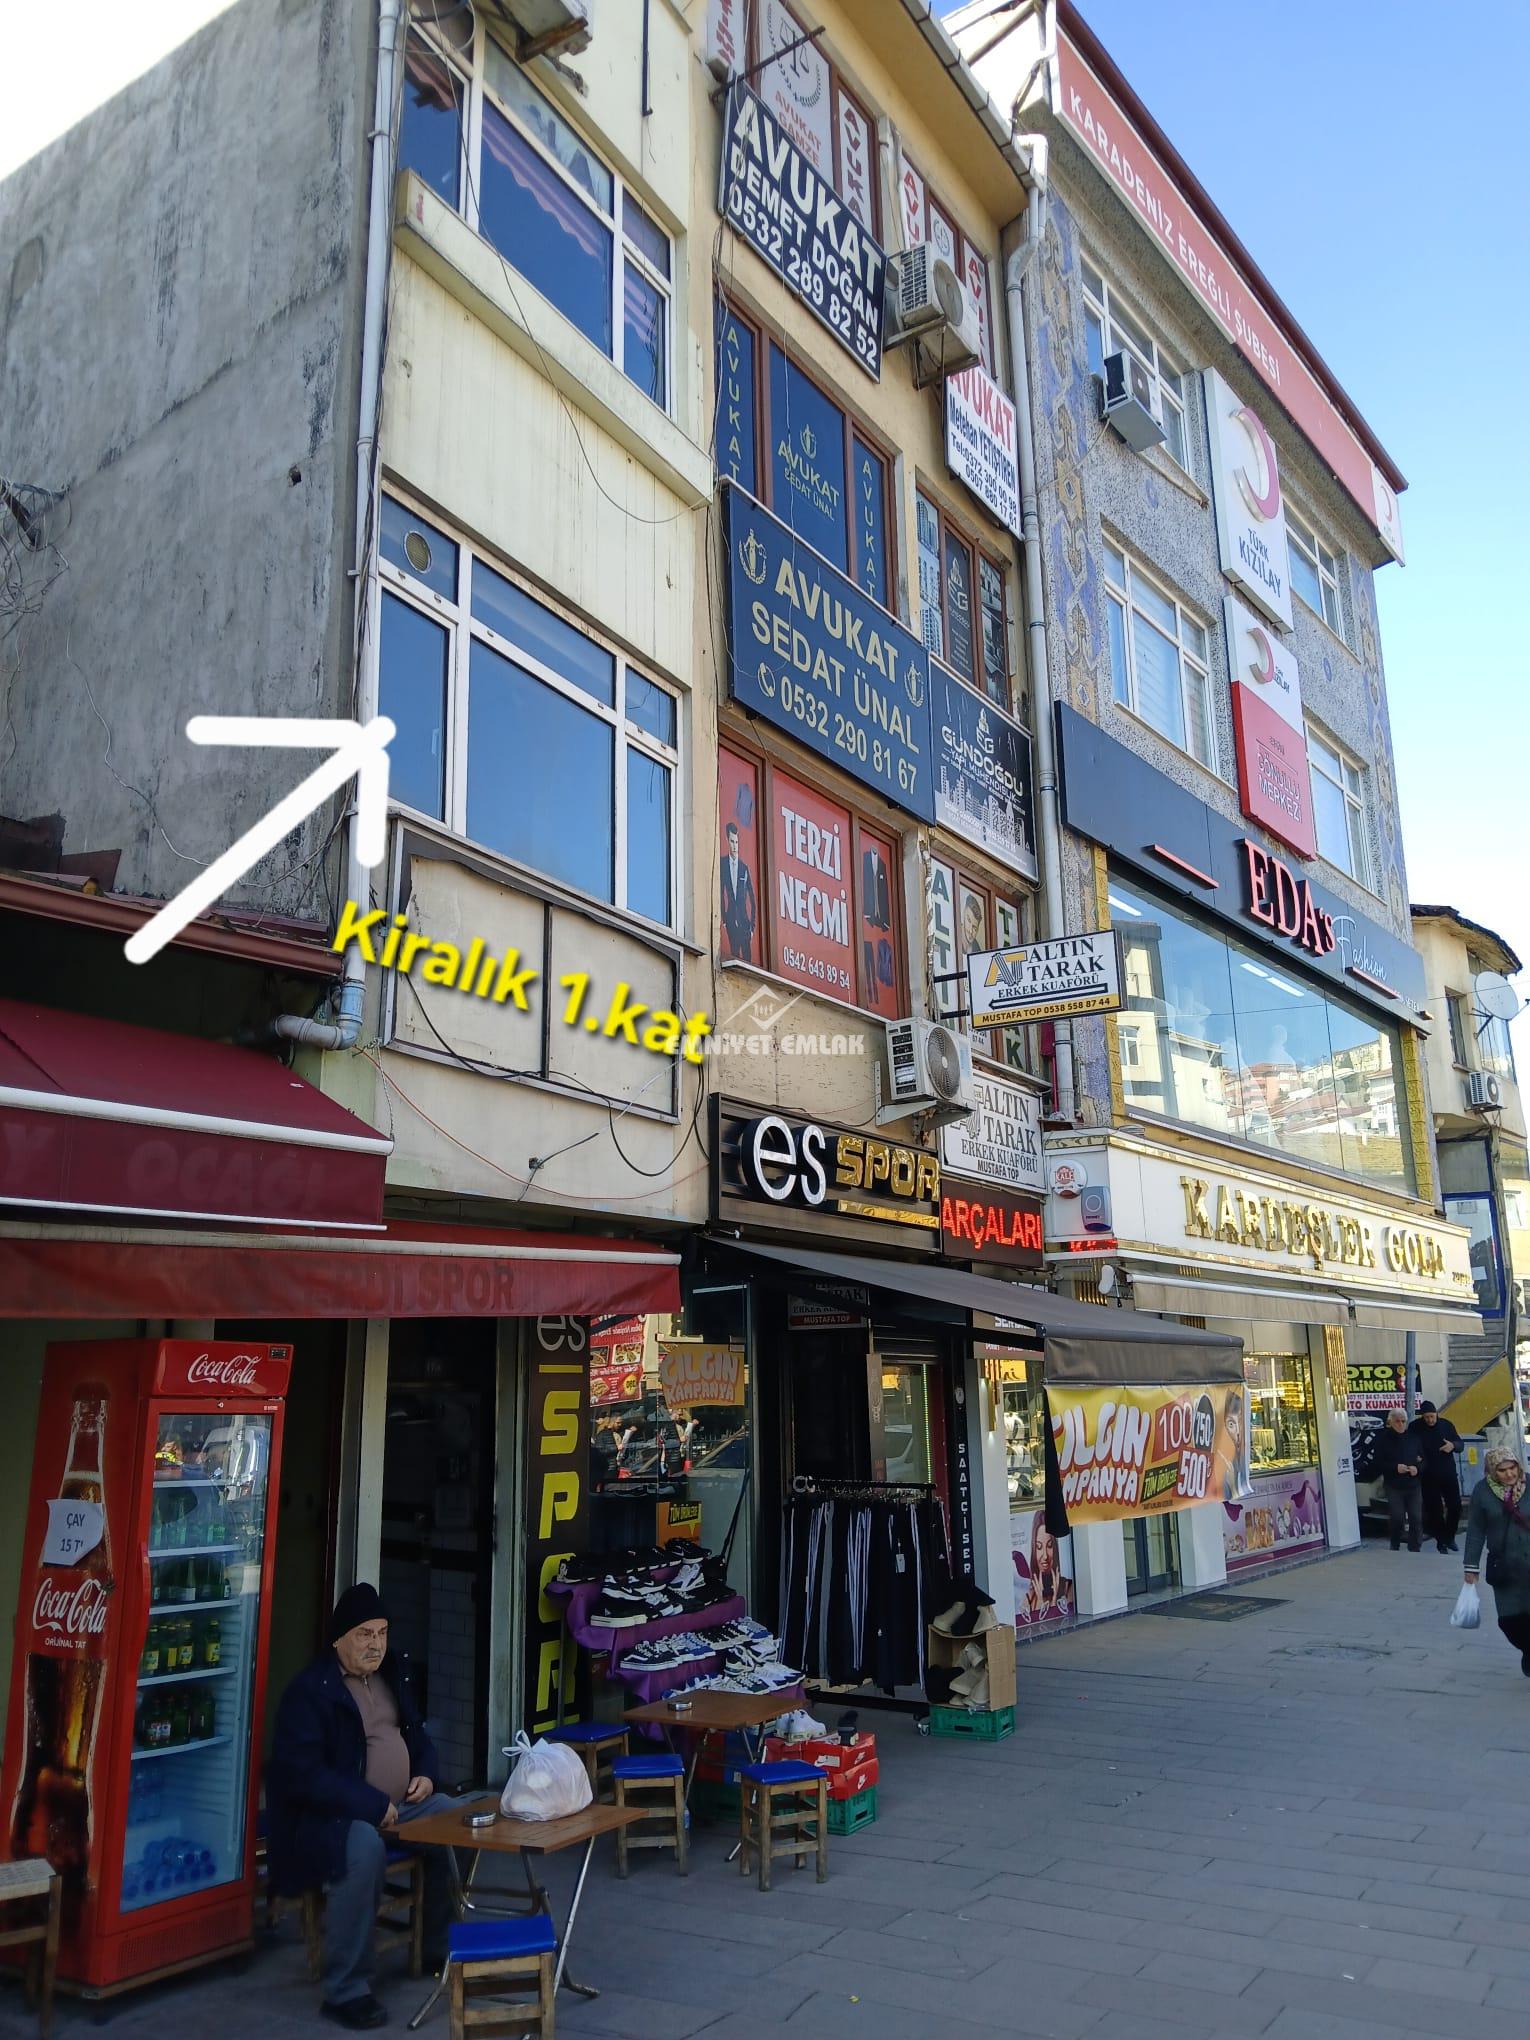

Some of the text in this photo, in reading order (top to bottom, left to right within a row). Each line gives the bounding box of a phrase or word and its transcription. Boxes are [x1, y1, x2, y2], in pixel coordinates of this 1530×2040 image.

[775, 90, 822, 151] AVUKAT
[843, 107, 865, 226] AVUKA
[734, 98, 882, 293] AVUKAT
[903, 170, 920, 249] AVU
[730, 142, 879, 335] DEMET DOĞAN
[1069, 85, 1282, 387] KARADENİZ EREĞLİ ŞUBESİ
[729, 183, 878, 368] 0532 289 82 52
[726, 326, 742, 482] AVUKAT
[949, 369, 1013, 452] AVUKAT
[949, 393, 978, 449] Metehan
[777, 439, 840, 507] AVUKAT
[784, 468, 812, 501] SEDAT
[862, 459, 876, 598] AVUKAT
[1247, 528, 1270, 562] TÜRK
[1239, 535, 1282, 599] KIZILAY
[774, 557, 899, 683] AVUKAT
[751, 601, 846, 698] SEDAT
[853, 667, 920, 755] ÜNAL
[780, 675, 829, 738] 0532
[834, 713, 867, 762] 290
[872, 740, 892, 779] 81
[897, 756, 918, 795] 67
[1257, 752, 1301, 800] GÖNÜLLÜ
[781, 806, 842, 881] TERZİ
[778, 869, 850, 947] NECMİ
[1244, 838, 1387, 983] EDA's Fashion
[783, 945, 851, 989] 0542 643 89 54
[1027, 937, 1095, 964] ALTIN
[1027, 954, 1106, 982] TARAK
[982, 997, 1111, 1024] MUSTAFA TOP 0538 558 87 44
[998, 972, 1100, 999] ERKEK KUAFÖRÜ
[983, 1085, 1030, 1125] ALTIN
[753, 1116, 940, 1205] es SPOR
[961, 1139, 1038, 1174] ERKEK KUAFÖRÜ
[984, 1115, 1038, 1156] TARAK
[977, 1159, 1019, 1181] MUSTAFA TOP
[942, 1197, 1042, 1250] ARÇALARI
[1179, 1174, 1447, 1279] KARDEŞLER GOLD
[187, 1353, 263, 1385] Coca-Cola
[1348, 1379, 1397, 1392] İLİNGİR
[1063, 1467, 1139, 1504] MPANYA
[60, 1539, 72, 1552] 15
[66, 1513, 86, 1529] ÇAY
[32, 1577, 108, 1634] Coca-Cola
[44, 1637, 87, 1649] ORİJİNAL TAT
